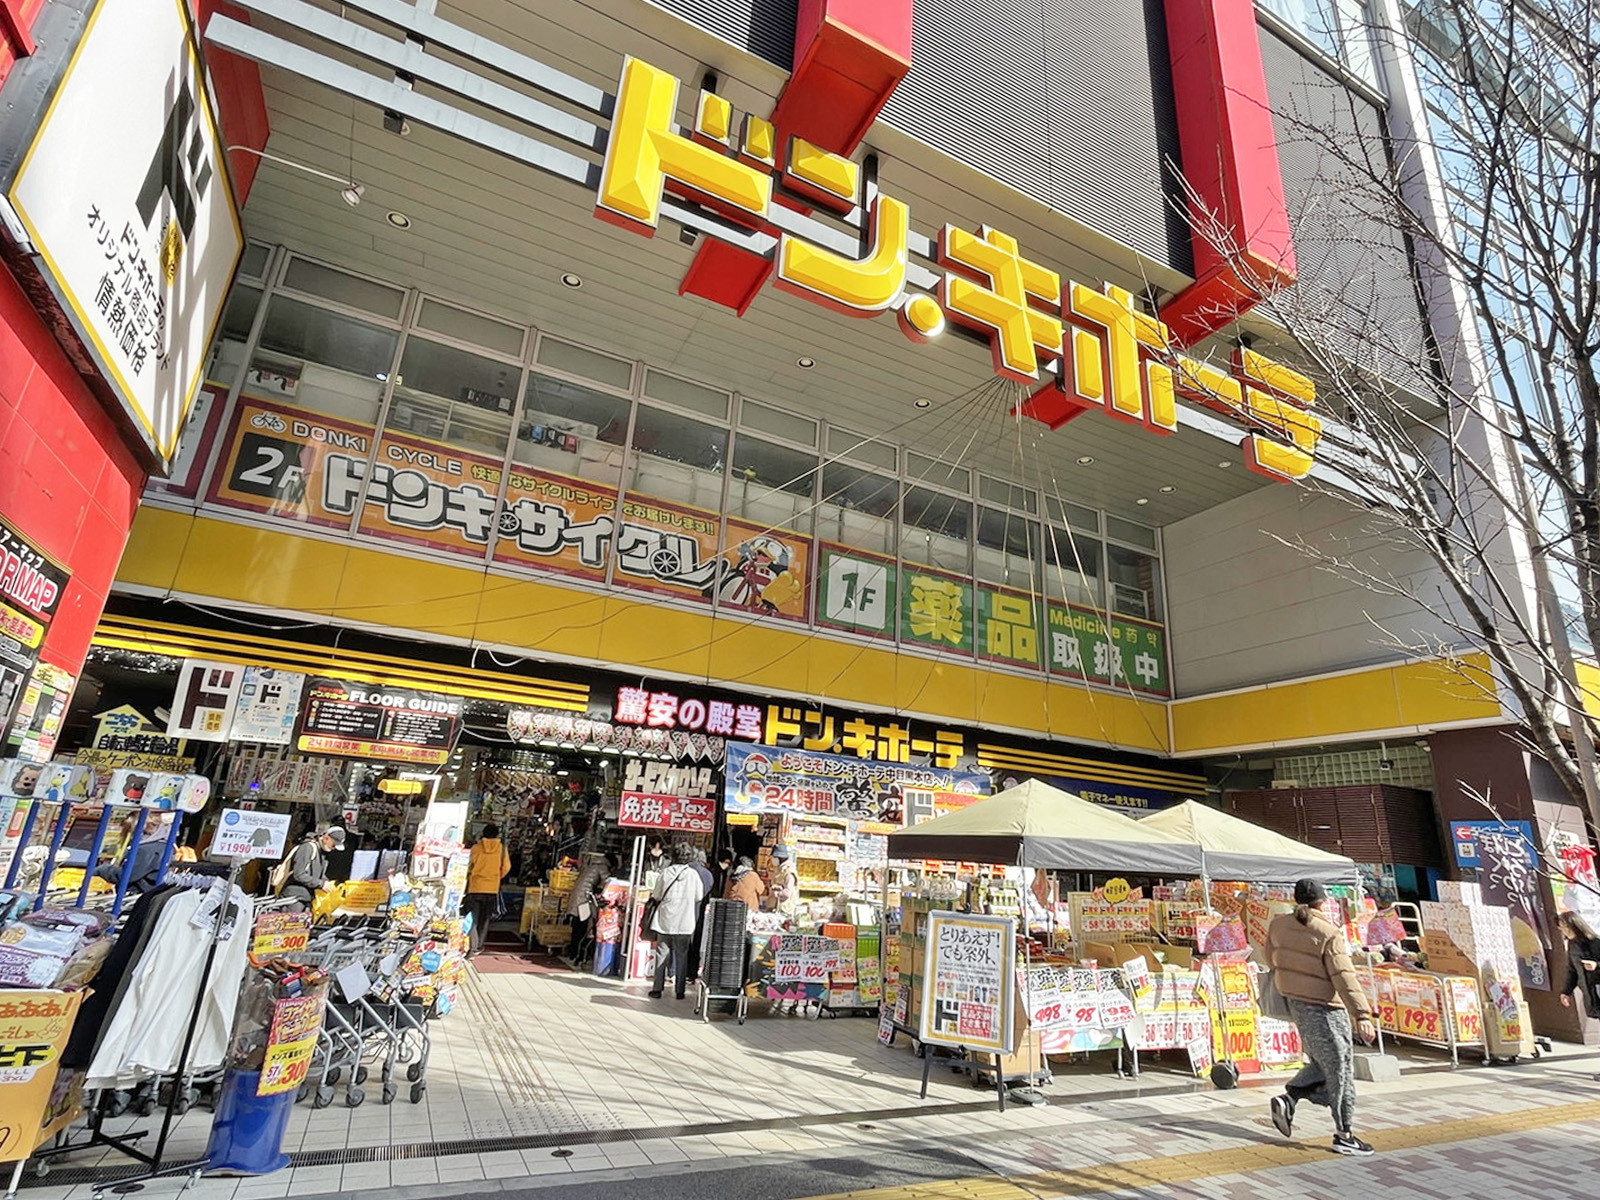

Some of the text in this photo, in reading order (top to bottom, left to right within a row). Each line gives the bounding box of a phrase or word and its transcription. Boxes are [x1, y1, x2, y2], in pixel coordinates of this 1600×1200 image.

[292, 421, 463, 474] DONKI CYCLE
[0, 526, 45, 569] アーマップ
[841, 571, 877, 613] 1F
[1050, 607, 1121, 640] Medicie
[1052, 632, 1160, 685] 取扱中
[350, 690, 405, 708] FLOOR
[408, 698, 459, 715] GUIDE
[615, 686, 763, 741] 驚安の殿堂
[623, 758, 718, 800] サービスカウンター
[677, 798, 708, 816] Tax
[764, 786, 834, 816] 24時間
[669, 813, 714, 831] Free
[281, 935, 305, 949] 300
[939, 926, 1000, 948] とりあえず!
[781, 965, 801, 976] 100
[1075, 1007, 1097, 1023] 98
[1404, 1008, 1439, 1033] 198
[1459, 1014, 1479, 1036] 198
[1272, 1031, 1299, 1055] 498
